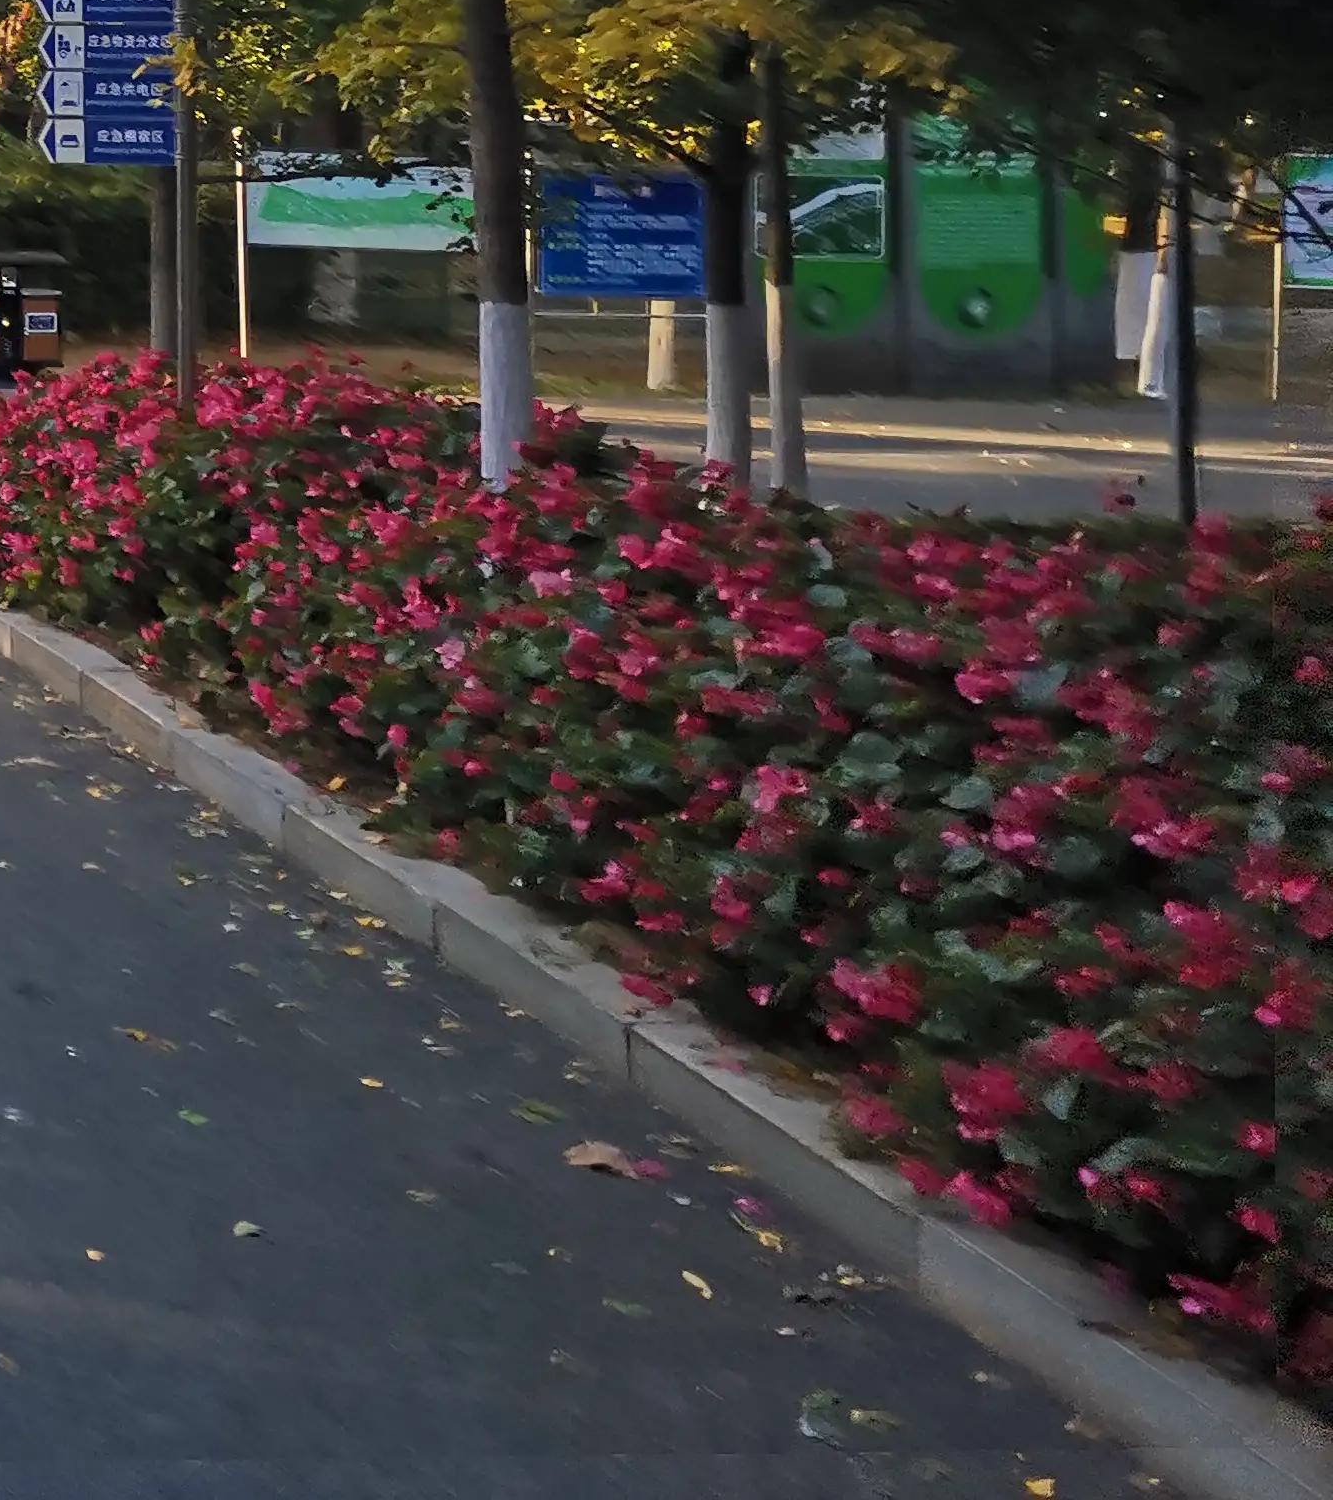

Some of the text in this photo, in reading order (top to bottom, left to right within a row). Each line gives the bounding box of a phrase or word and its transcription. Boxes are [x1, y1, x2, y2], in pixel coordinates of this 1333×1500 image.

[87, 34, 173, 49] 应急物资分发区
[94, 82, 165, 97] 应急供电区
